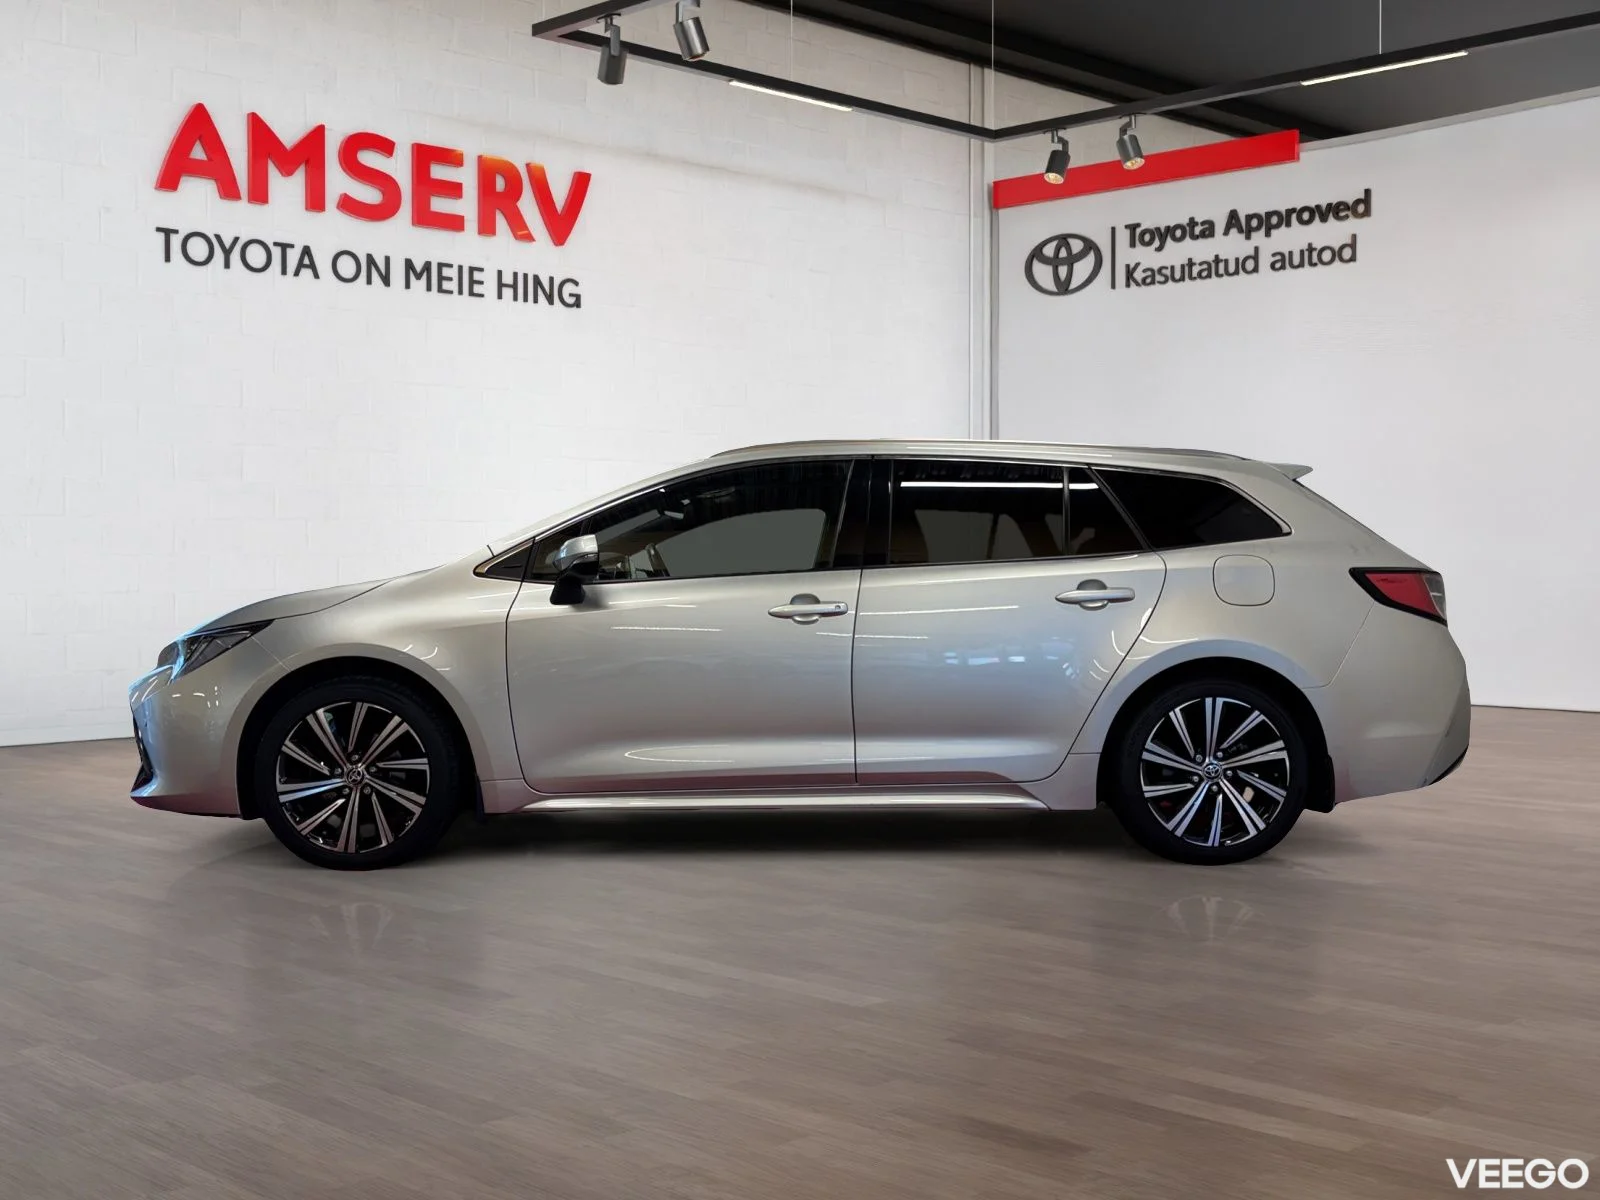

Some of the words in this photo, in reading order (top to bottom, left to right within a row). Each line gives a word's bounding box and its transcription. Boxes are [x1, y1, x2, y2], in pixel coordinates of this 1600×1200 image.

[155, 102, 592, 247] AMSERV
[1125, 217, 1216, 252] Toyota
[1223, 188, 1372, 239] Approved
[155, 227, 320, 279] TOYOTA
[331, 250, 391, 287] ON
[404, 258, 485, 298] MEIE
[497, 269, 582, 309] HING
[1125, 246, 1260, 288] Kasutatud
[1270, 234, 1357, 272] autod
